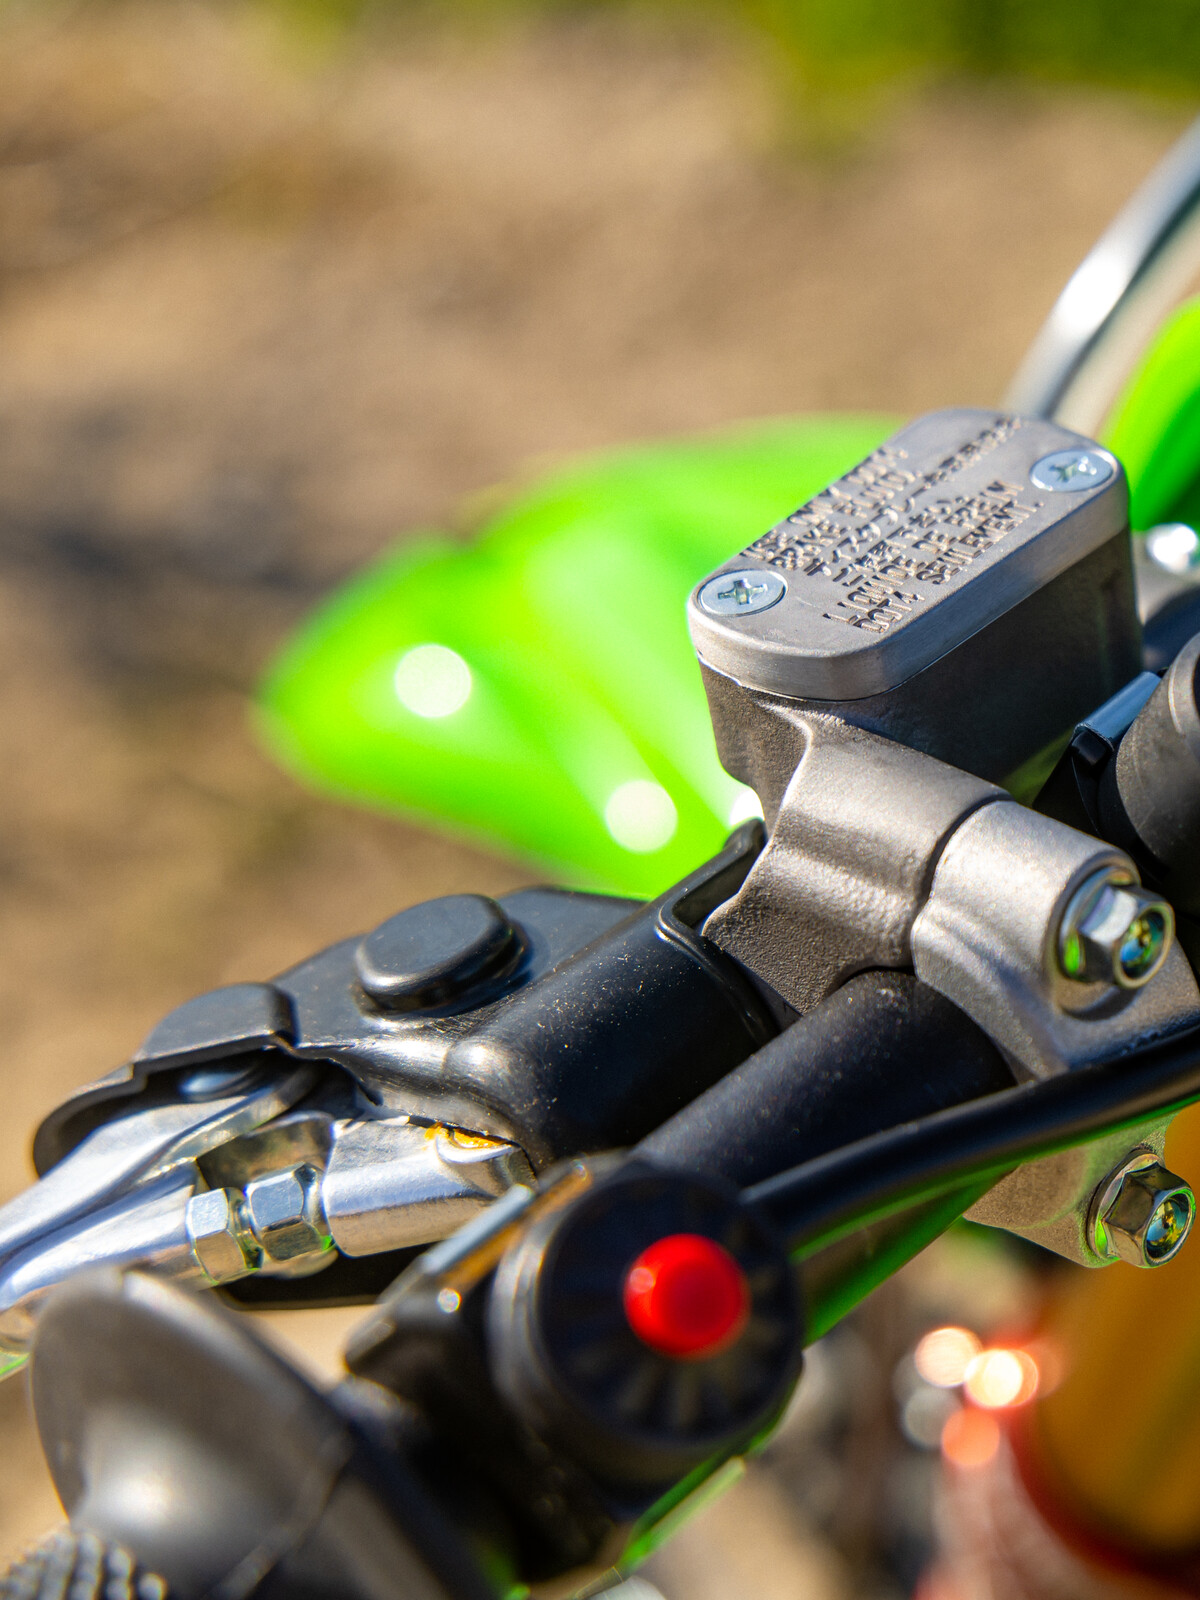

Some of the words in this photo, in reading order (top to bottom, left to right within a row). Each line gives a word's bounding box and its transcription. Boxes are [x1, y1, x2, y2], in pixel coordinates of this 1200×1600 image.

[768, 519, 852, 571] BRAKE
[823, 553, 928, 623] LIQUIDE
[912, 529, 961, 554] DE
[944, 480, 1025, 529] FREIN
[853, 590, 925, 633] DOT4
[916, 500, 1045, 585] SEULEMENT.
